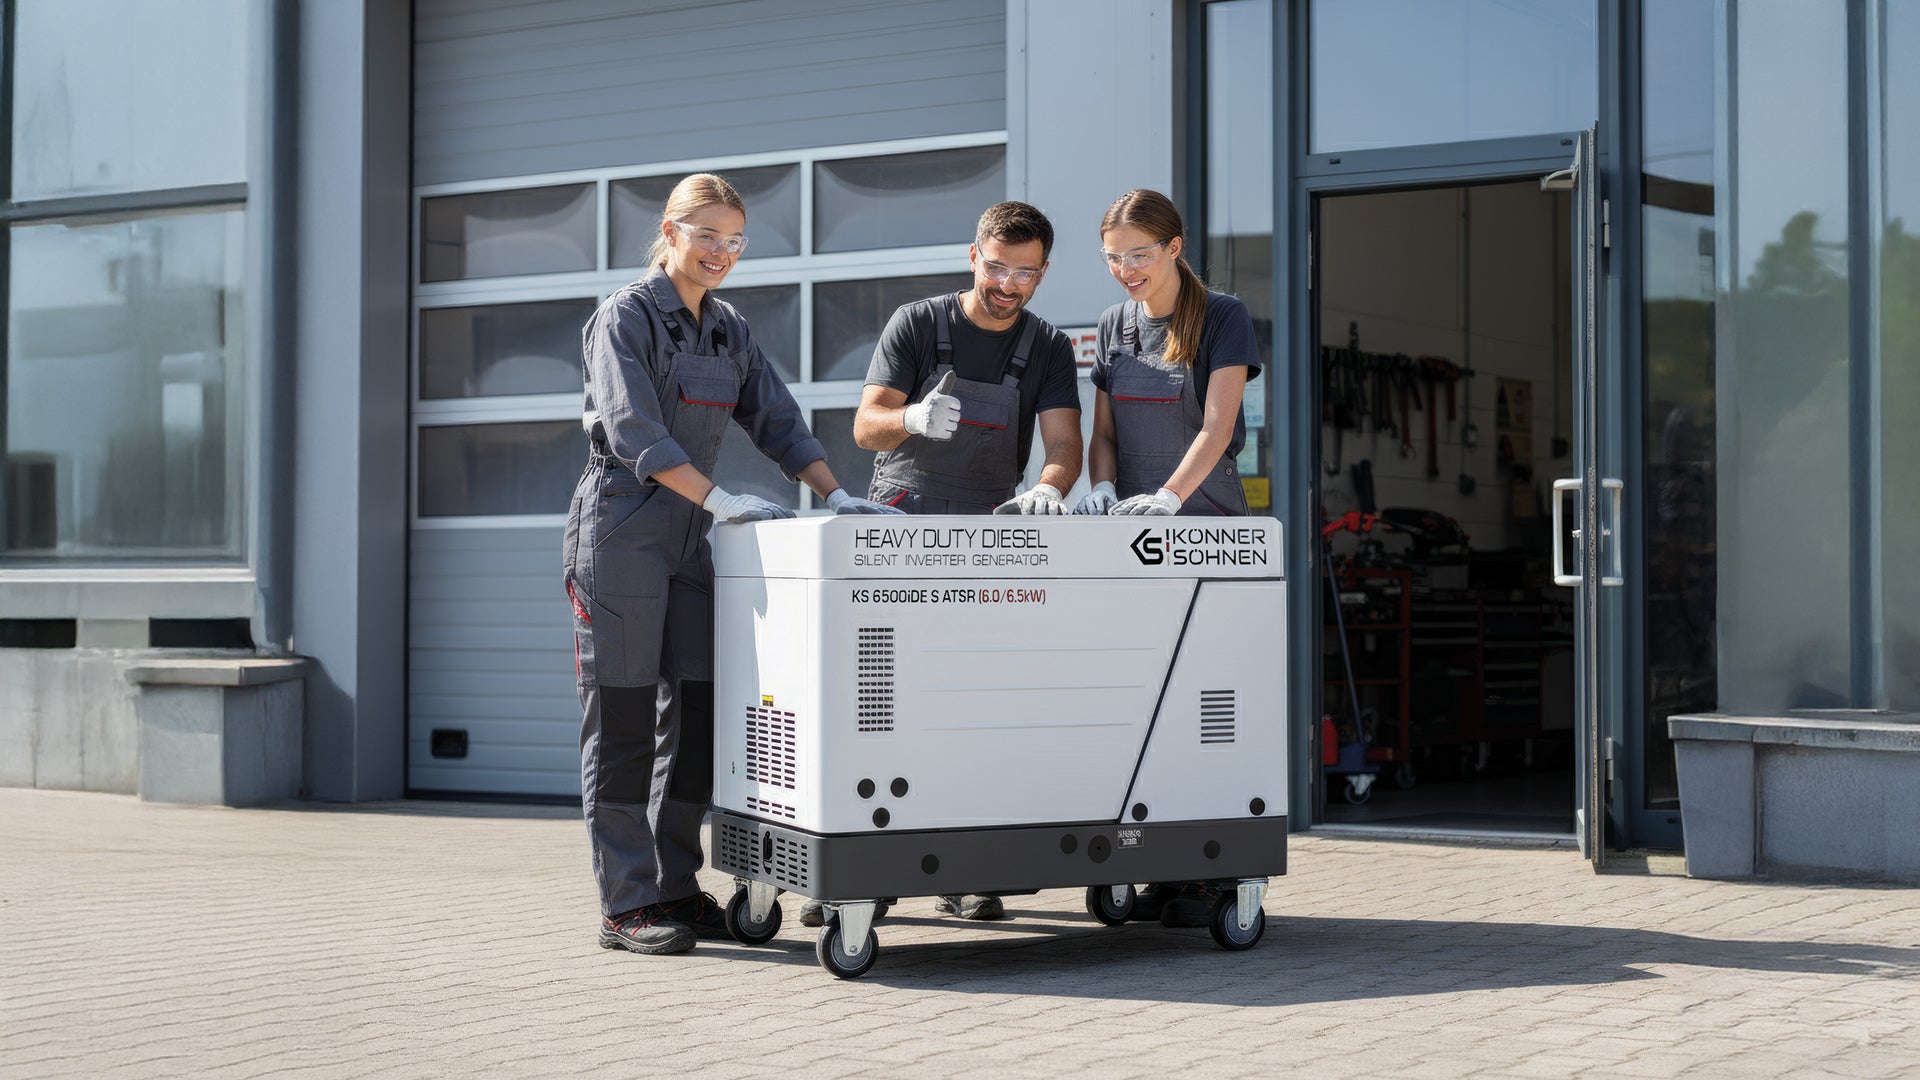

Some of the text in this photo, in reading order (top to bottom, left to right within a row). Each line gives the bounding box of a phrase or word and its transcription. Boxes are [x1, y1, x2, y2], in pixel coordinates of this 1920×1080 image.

[855, 528, 1048, 548] HEAVY DUTY DIESEL
[1172, 528, 1266, 544] KÖNNER
[854, 554, 1049, 566] SILENT INVERTER GENERATOR
[1173, 549, 1267, 565] SÖHNEN
[852, 589, 1046, 604] KS 6500iDE S ATSR (6.0/6.5kW)
